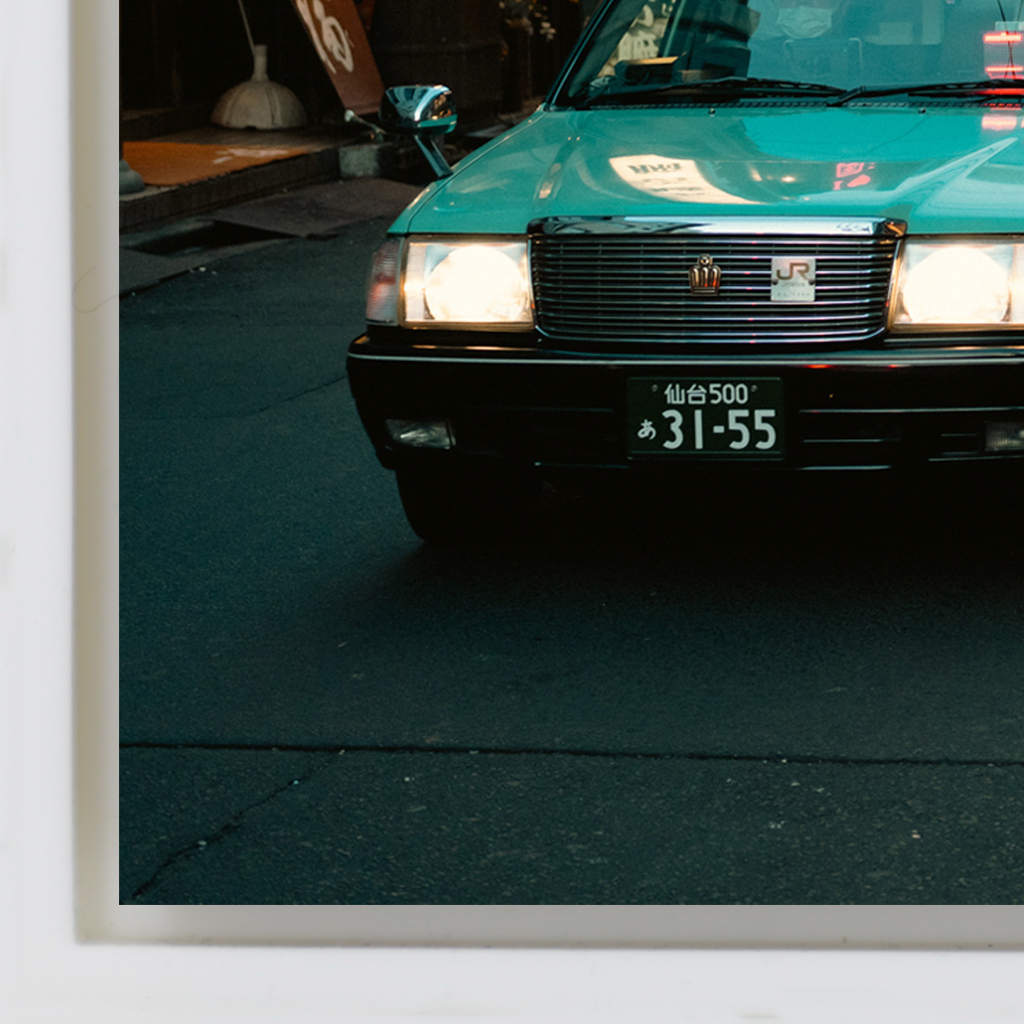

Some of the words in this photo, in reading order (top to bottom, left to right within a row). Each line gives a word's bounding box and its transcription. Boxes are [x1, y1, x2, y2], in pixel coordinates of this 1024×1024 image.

[776, 262, 810, 280] JR
[637, 419, 657, 440] あ
[662, 409, 776, 449] 31-55
